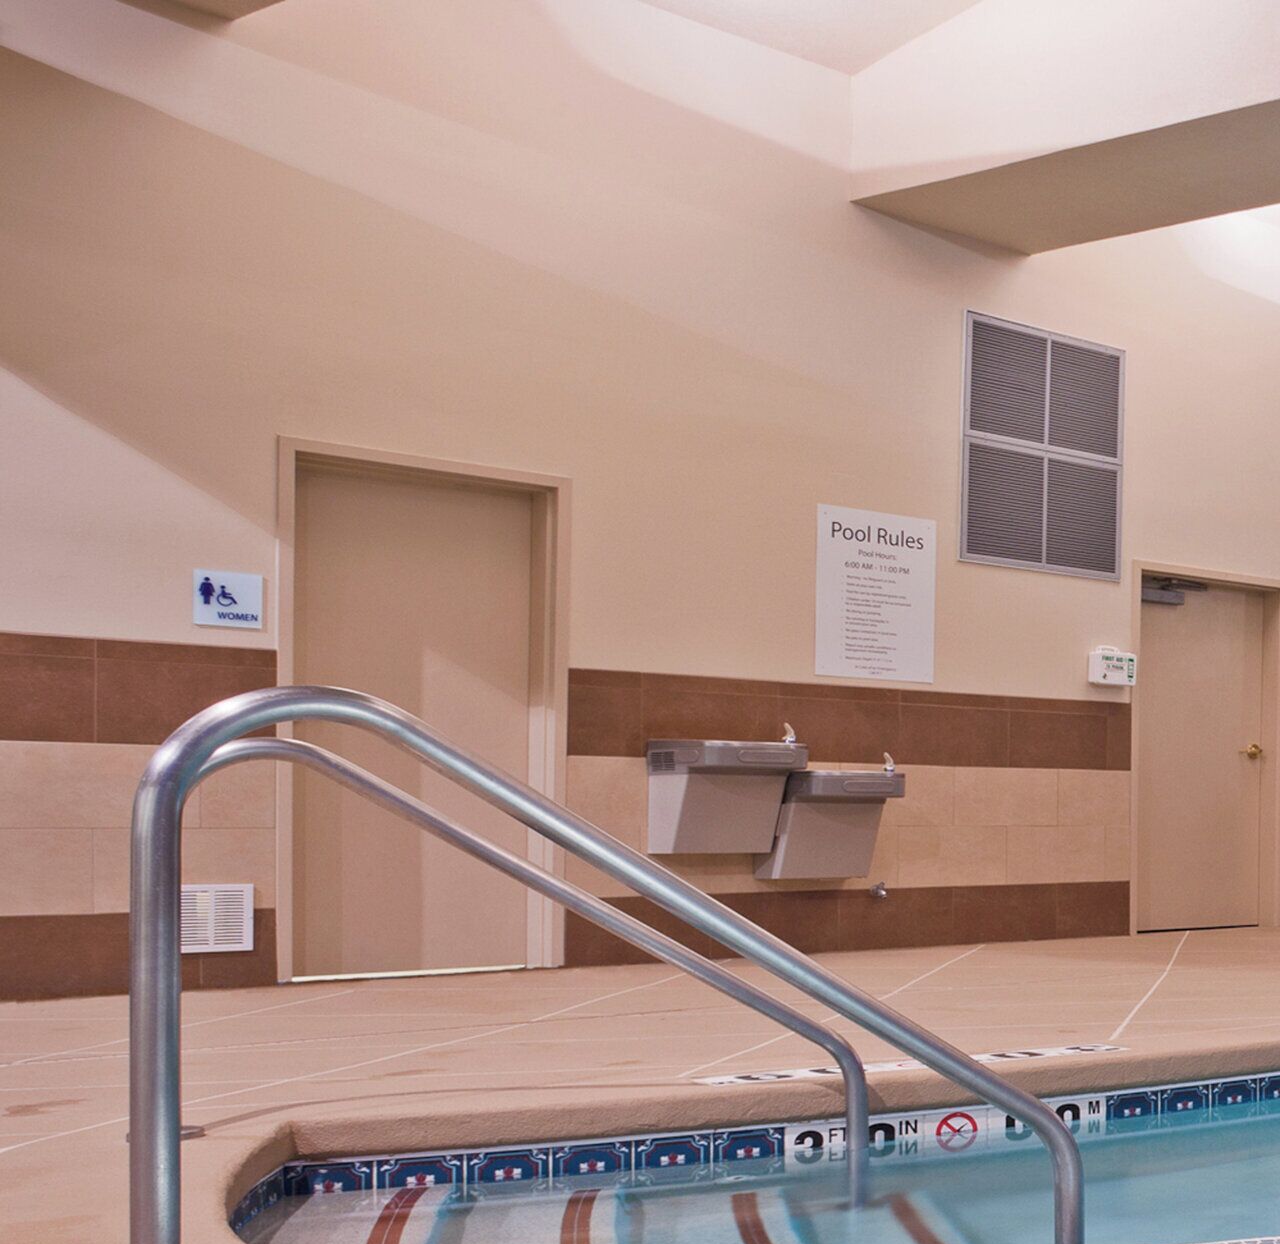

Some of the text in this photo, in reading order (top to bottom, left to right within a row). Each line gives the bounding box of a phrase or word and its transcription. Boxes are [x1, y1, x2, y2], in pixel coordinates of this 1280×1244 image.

[831, 521, 924, 550] Pool Rules
[858, 549, 874, 558] Pool
[844, 561, 860, 570] 6:00
[861, 562, 873, 570] AM
[879, 564, 898, 574] 11:00
[899, 566, 910, 575] PM
[217, 611, 259, 621] WOMEN
[899, 1119, 918, 1136] IN
[1088, 1101, 1100, 1114] M
